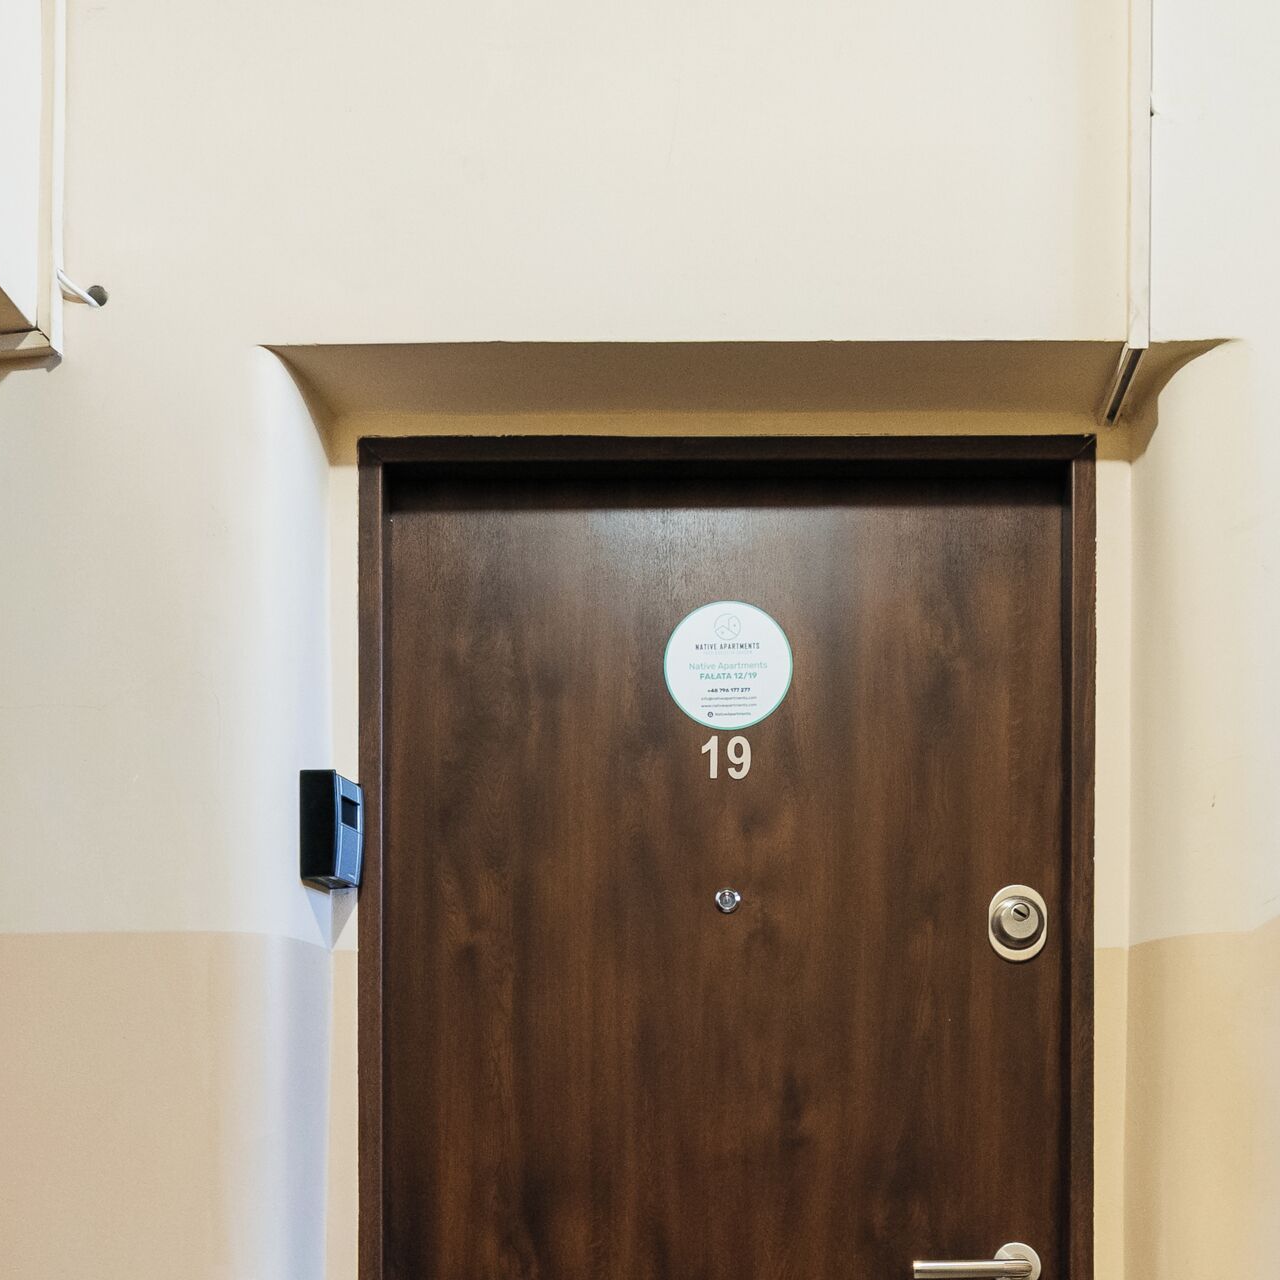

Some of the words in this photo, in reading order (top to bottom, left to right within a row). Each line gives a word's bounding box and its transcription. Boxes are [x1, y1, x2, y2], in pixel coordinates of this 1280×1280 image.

[719, 642, 760, 650] APARTMENTS
[718, 662, 768, 671] Apartments
[699, 672, 732, 680] FAŁATA
[734, 671, 758, 680] 12/19
[701, 735, 752, 780] 19
